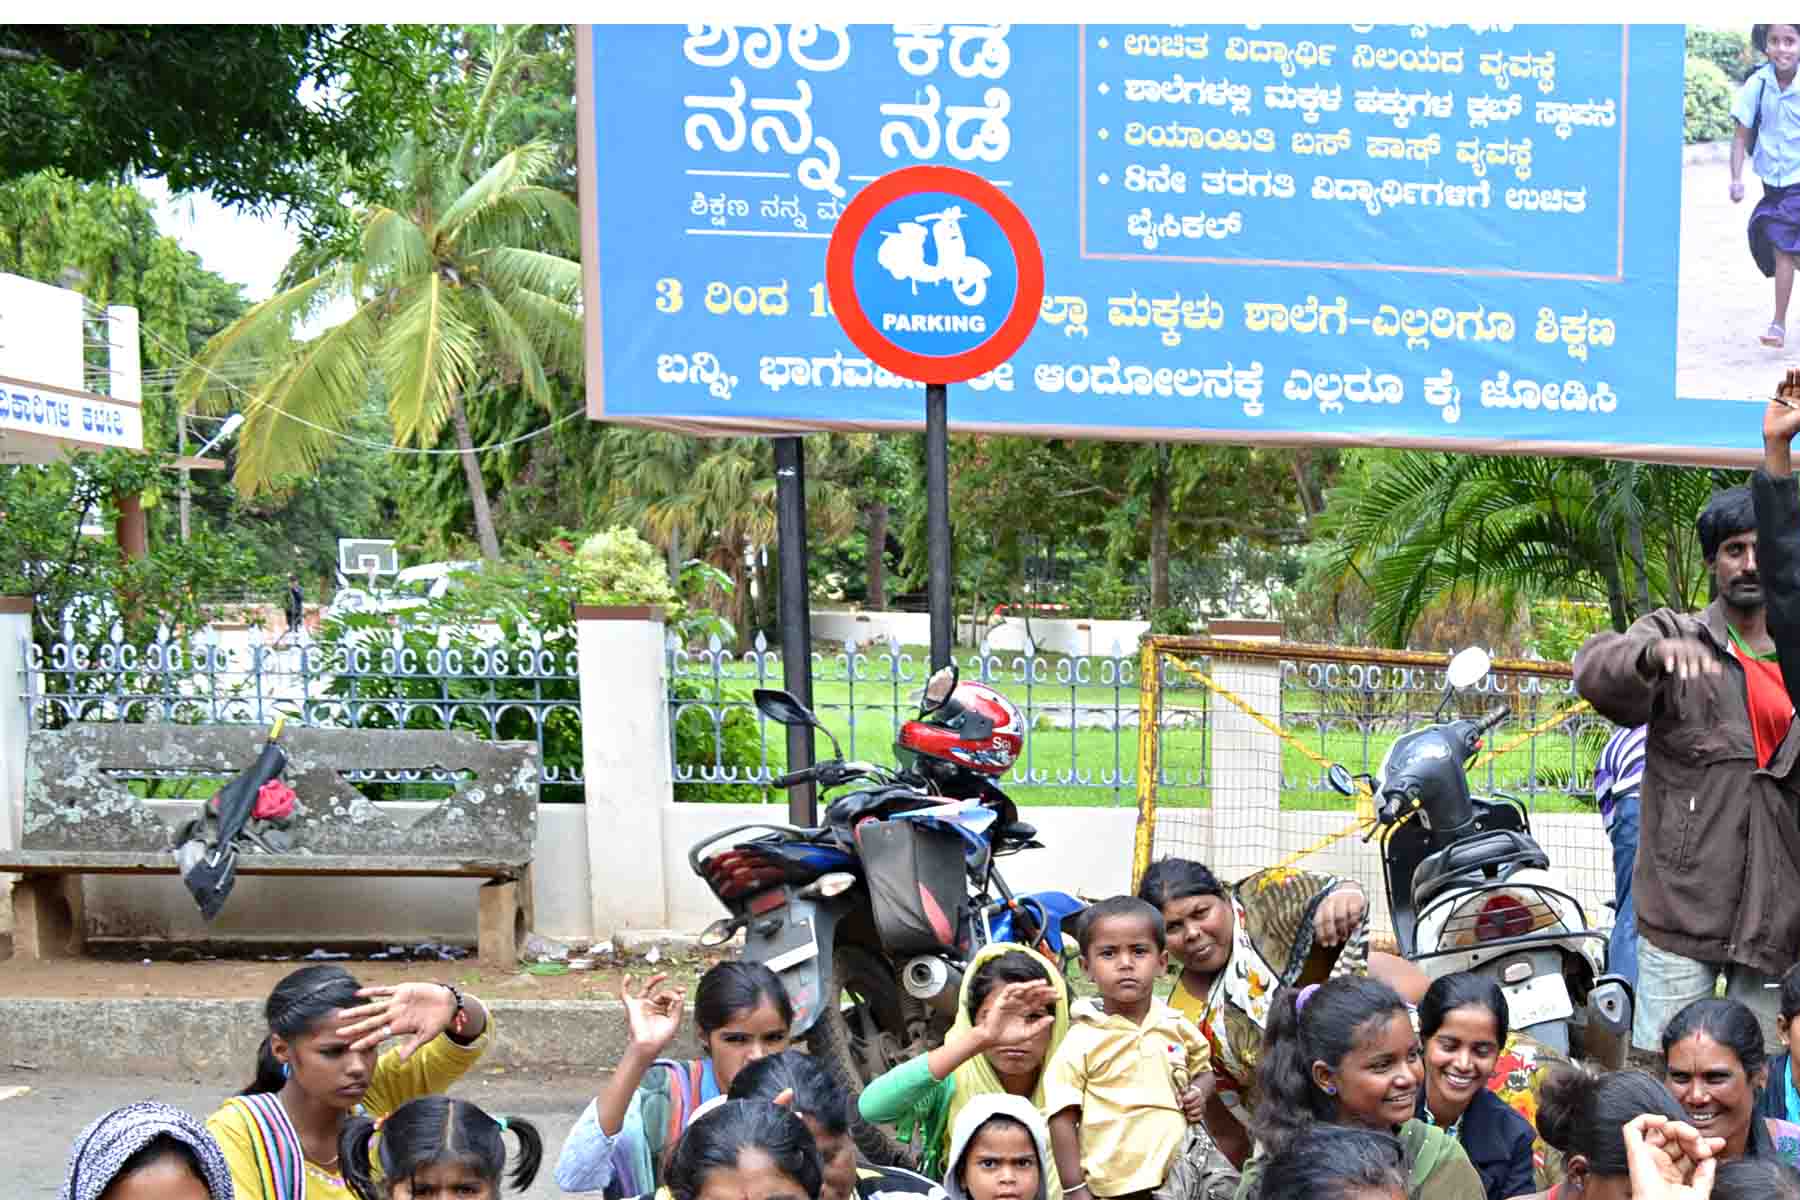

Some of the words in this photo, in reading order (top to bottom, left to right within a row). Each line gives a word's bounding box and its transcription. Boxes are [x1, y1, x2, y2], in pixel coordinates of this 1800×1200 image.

[1123, 33, 1209, 59] ಉಚಿತ
[1225, 36, 1337, 78] ವಿದ್ಯಾರ್ಥಿ
[1352, 44, 1464, 74] ನಿಲಯದ
[1479, 49, 1556, 94] ವ್ಯವಸ್ಥೆ
[1123, 73, 1251, 116] ಶಾಲೆಗಳಲ್ಲಿ
[1264, 82, 1343, 124] ಮಕ್ಕಳ
[683, 76, 846, 198] ನನ್ನ
[880, 84, 1011, 162] ನಡೆ
[1123, 121, 1276, 153] ರಿಯಾಯಿತಿ
[1291, 128, 1352, 156] ಬಸ್
[1366, 133, 1441, 162] ಪಾಸ್
[1456, 136, 1533, 181] ವ್ಯವಸ್ಥೆ
[690, 191, 749, 226] ಶಿಕ್ಷಣ
[760, 194, 808, 231] ನನ್ನ
[1201, 168, 1296, 198] ತರಗತಿ
[1505, 186, 1587, 213] ಉಚಿತ
[1127, 207, 1243, 250] ಬೈಸಿಕಲ್
[656, 277, 683, 314] 3
[704, 278, 789, 316] ರಿಂದ
[809, 282, 835, 318] 1
[1038, 294, 1088, 341] ಲ್ಲಾ
[1107, 288, 1225, 346] ಮಕ್ಕಳು
[1535, 306, 1616, 362] ಶಿಕ್ಷಣ
[883, 312, 986, 333] PARKING
[1034, 356, 1264, 417] ಆಂದೋಲನಕ್ಕೆ
[1283, 367, 1404, 415] ಎಲ್ಲರೂ
[1424, 368, 1462, 423] ಕೈ
[1480, 370, 1617, 413] ಜೋಡಿಸಿ
